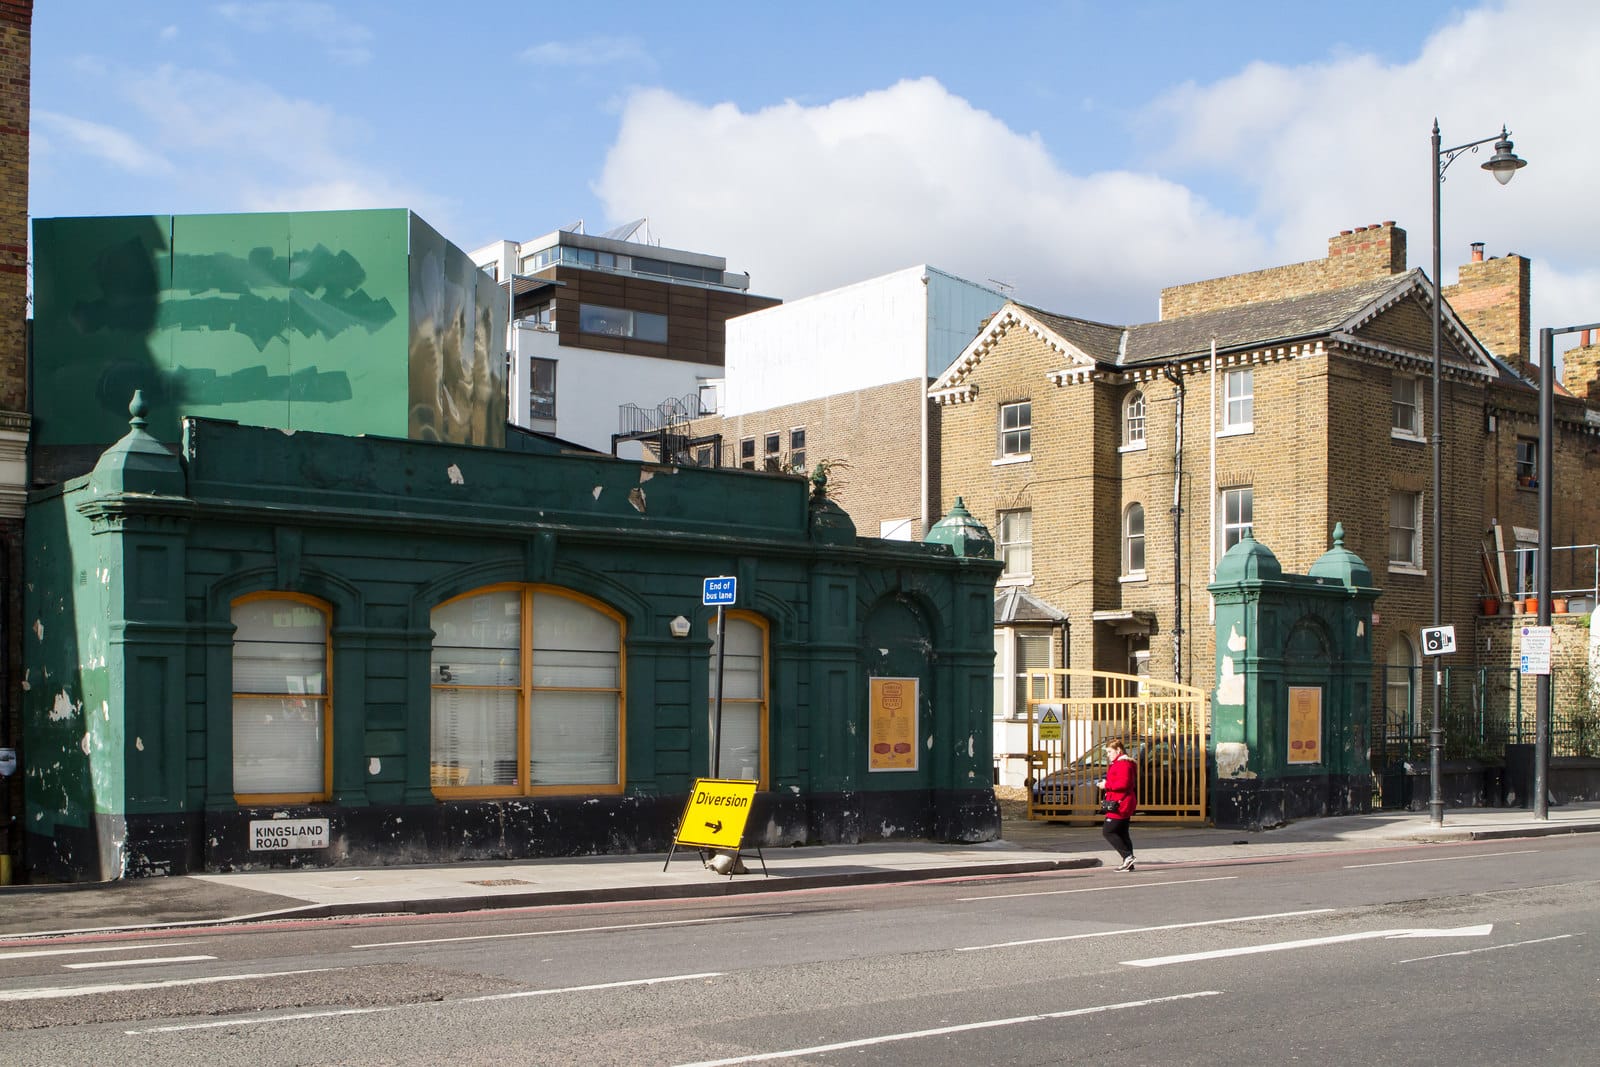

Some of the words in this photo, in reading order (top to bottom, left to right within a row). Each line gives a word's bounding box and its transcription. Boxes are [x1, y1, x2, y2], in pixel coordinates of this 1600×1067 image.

[710, 582, 722, 590] End
[723, 581, 730, 589] of
[706, 592, 717, 600] bus
[719, 592, 733, 600] lane
[439, 665, 452, 683] 5
[696, 792, 748, 807] Diversion
[256, 826, 323, 837] KINGSLAND
[256, 838, 289, 848] ROAD
